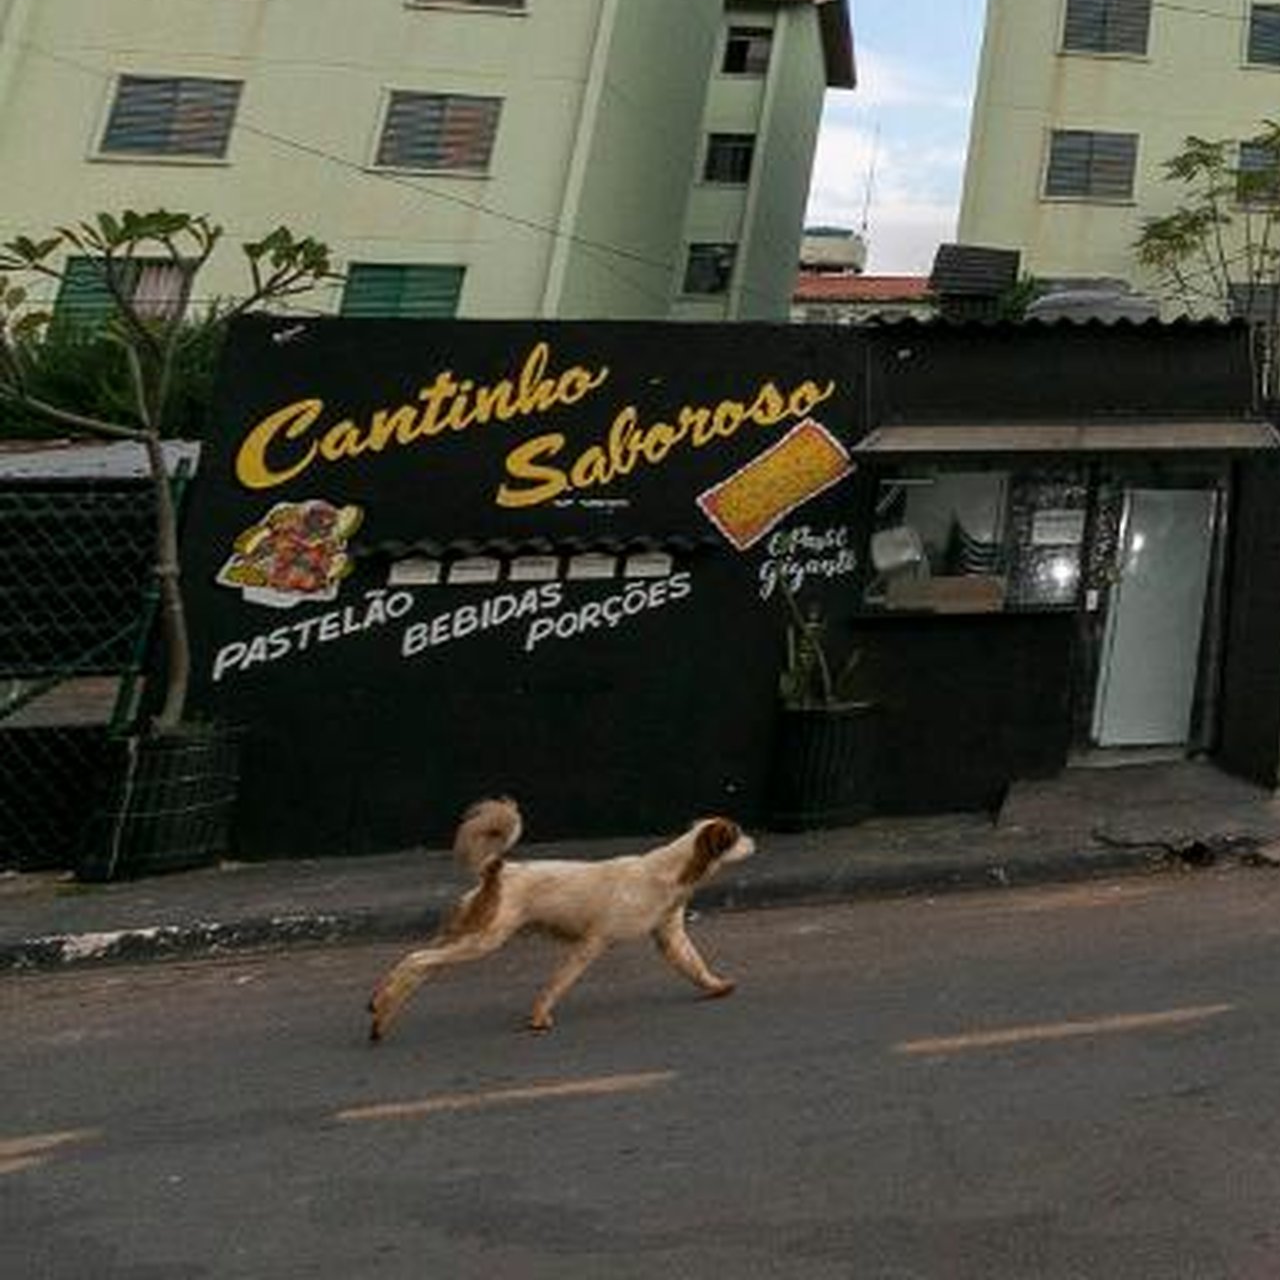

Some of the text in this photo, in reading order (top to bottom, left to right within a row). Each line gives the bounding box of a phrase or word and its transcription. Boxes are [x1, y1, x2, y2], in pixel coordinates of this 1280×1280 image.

[236, 342, 609, 489] Cantinho
[496, 380, 836, 507] Saboroso
[212, 589, 414, 681] PASTELÃO
[402, 582, 562, 657] BEBIDAS
[525, 571, 691, 651] PORÇÕES
